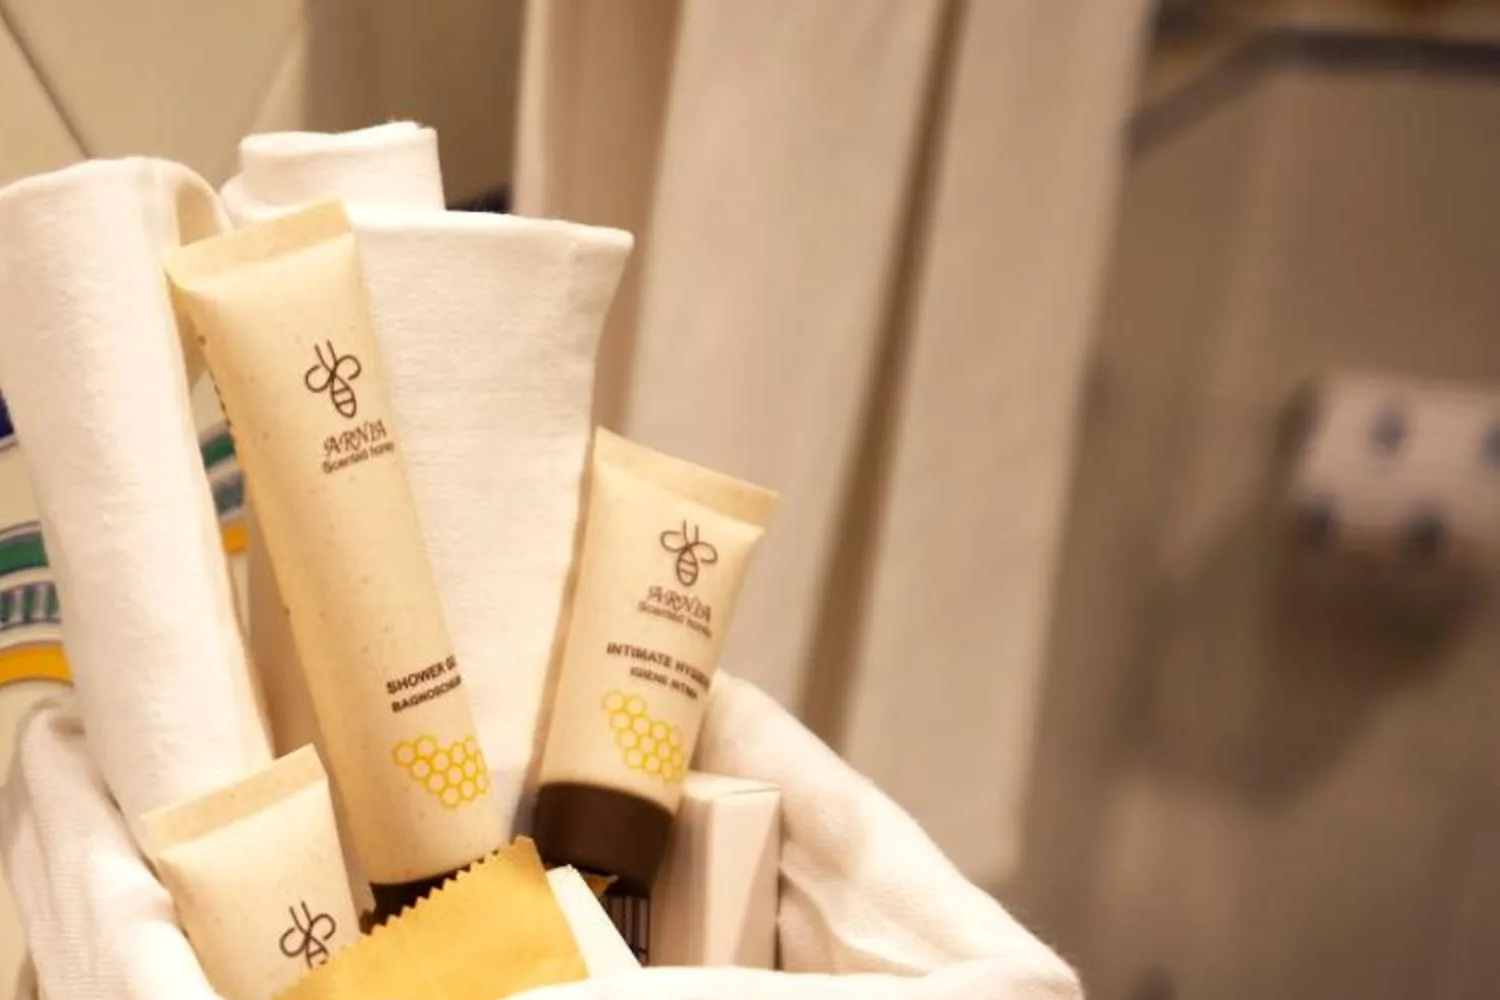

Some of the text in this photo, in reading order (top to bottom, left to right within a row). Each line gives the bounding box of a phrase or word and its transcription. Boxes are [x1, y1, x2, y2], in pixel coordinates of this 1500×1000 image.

[324, 418, 387, 457] ARNIA
[606, 642, 672, 668] INTIMATE
[386, 661, 447, 695] SHOWER
